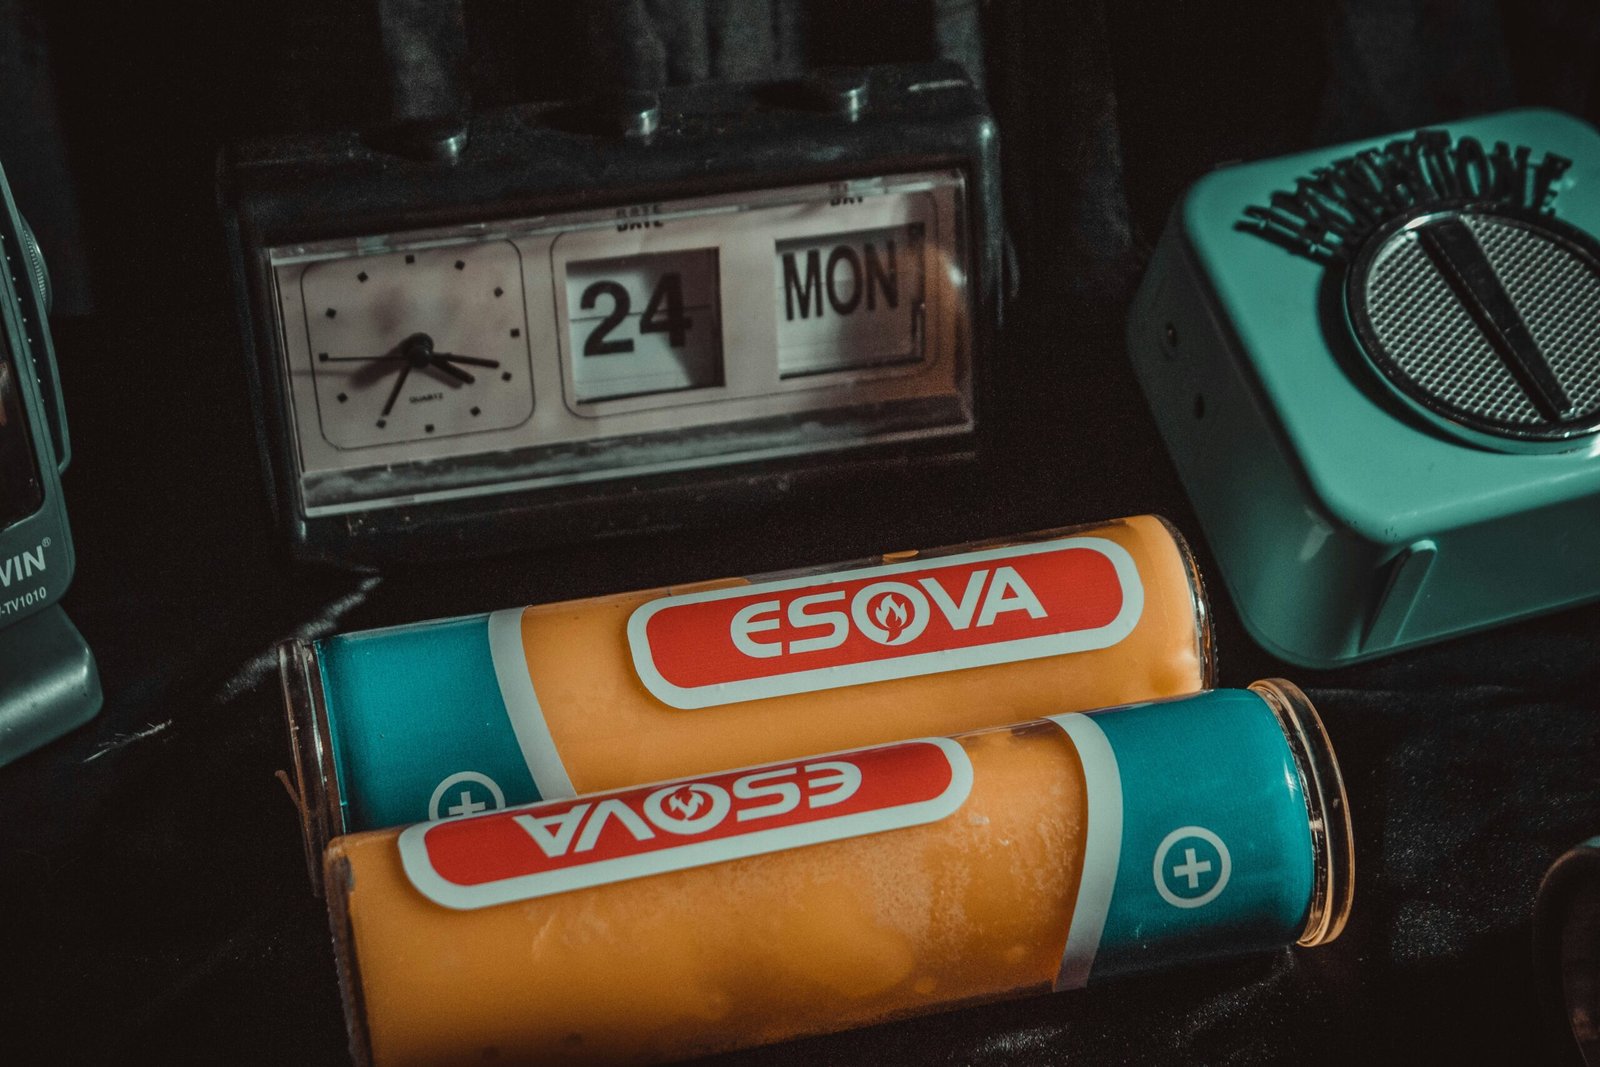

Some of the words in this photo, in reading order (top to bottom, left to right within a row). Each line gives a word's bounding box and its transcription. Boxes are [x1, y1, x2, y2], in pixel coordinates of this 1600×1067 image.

[580, 272, 693, 357] 24
[782, 240, 899, 321] MON
[0, 586, 47, 616] -TV1010
[730, 566, 1048, 659] ESOVA
[513, 761, 862, 858] ESOVA
